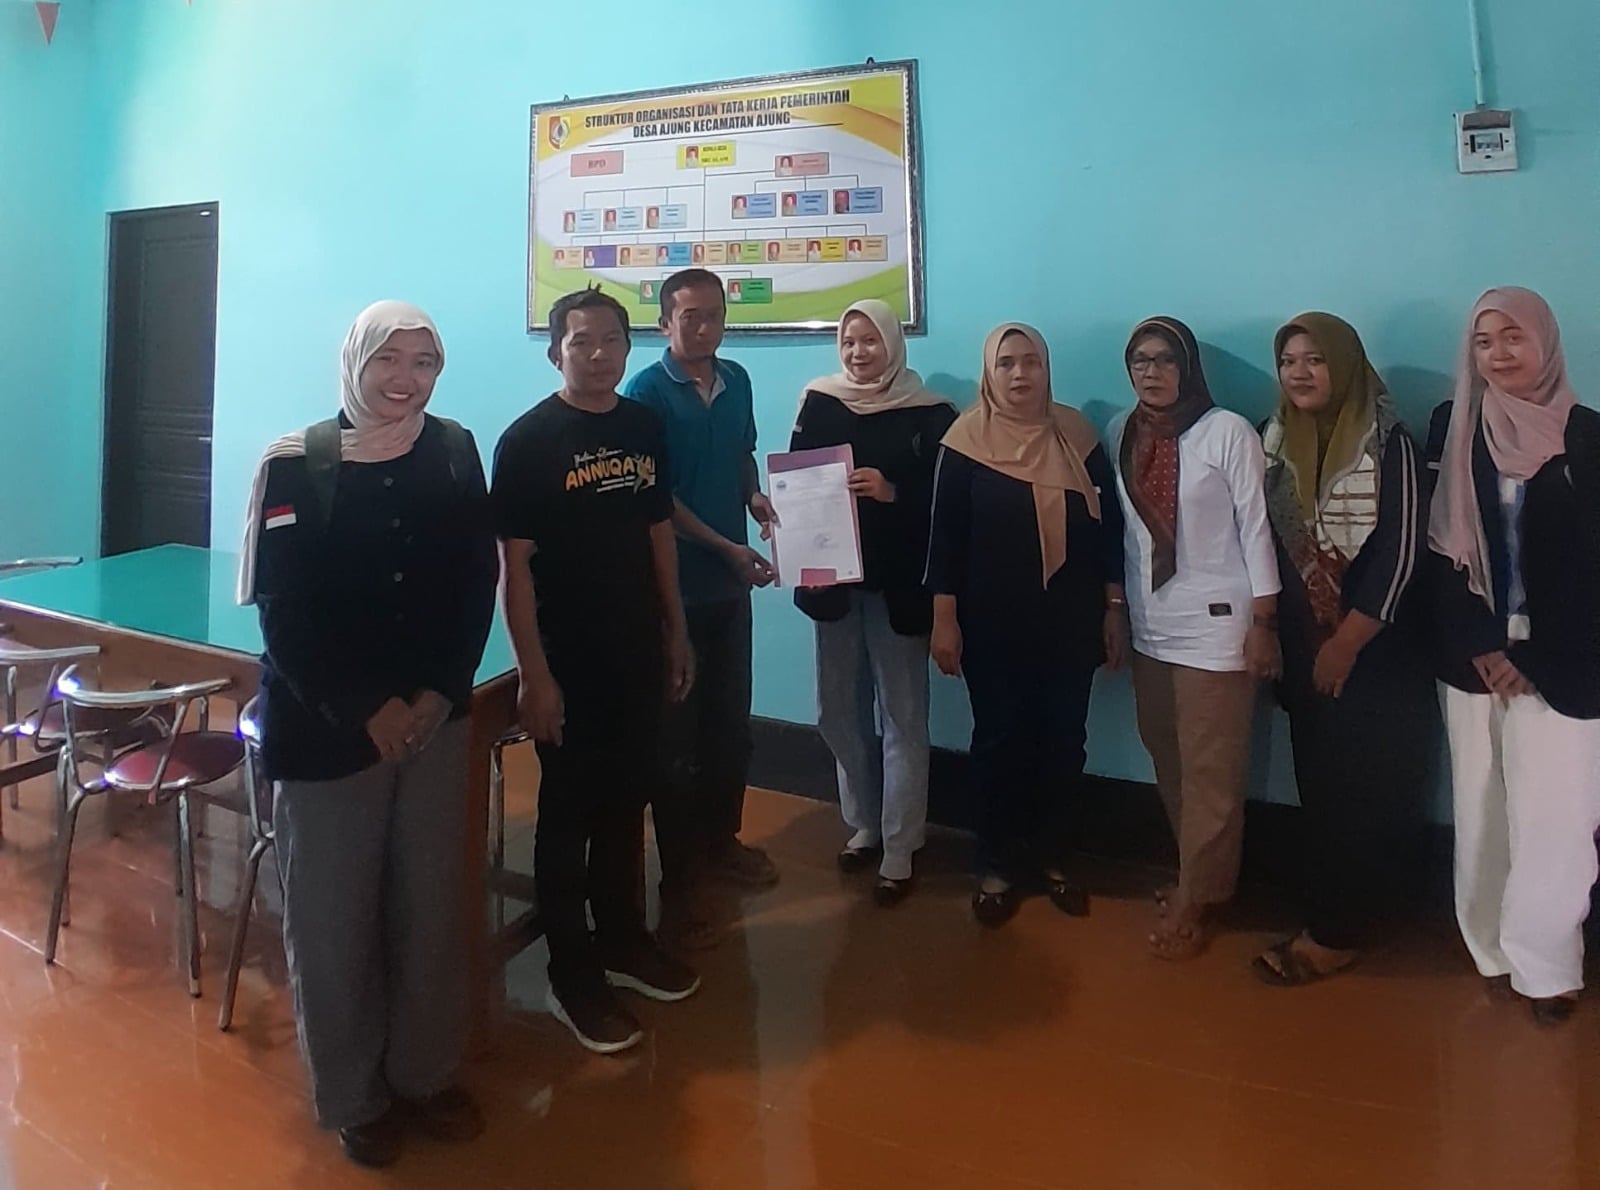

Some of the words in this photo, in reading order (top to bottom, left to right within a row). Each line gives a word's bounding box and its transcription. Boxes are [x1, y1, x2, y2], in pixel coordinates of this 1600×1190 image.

[585, 113, 634, 128] STRUKTUR
[636, 107, 695, 122] ORGANISASI
[698, 103, 718, 116] DAN
[721, 101, 744, 115] TATA
[746, 97, 777, 112] KERJA
[780, 89, 850, 109] PEMERINTAH
[633, 123, 657, 138] DESA
[659, 120, 690, 136] AJUNG
[693, 116, 754, 132] KECAMATAN
[756, 111, 790, 127] AJUNG
